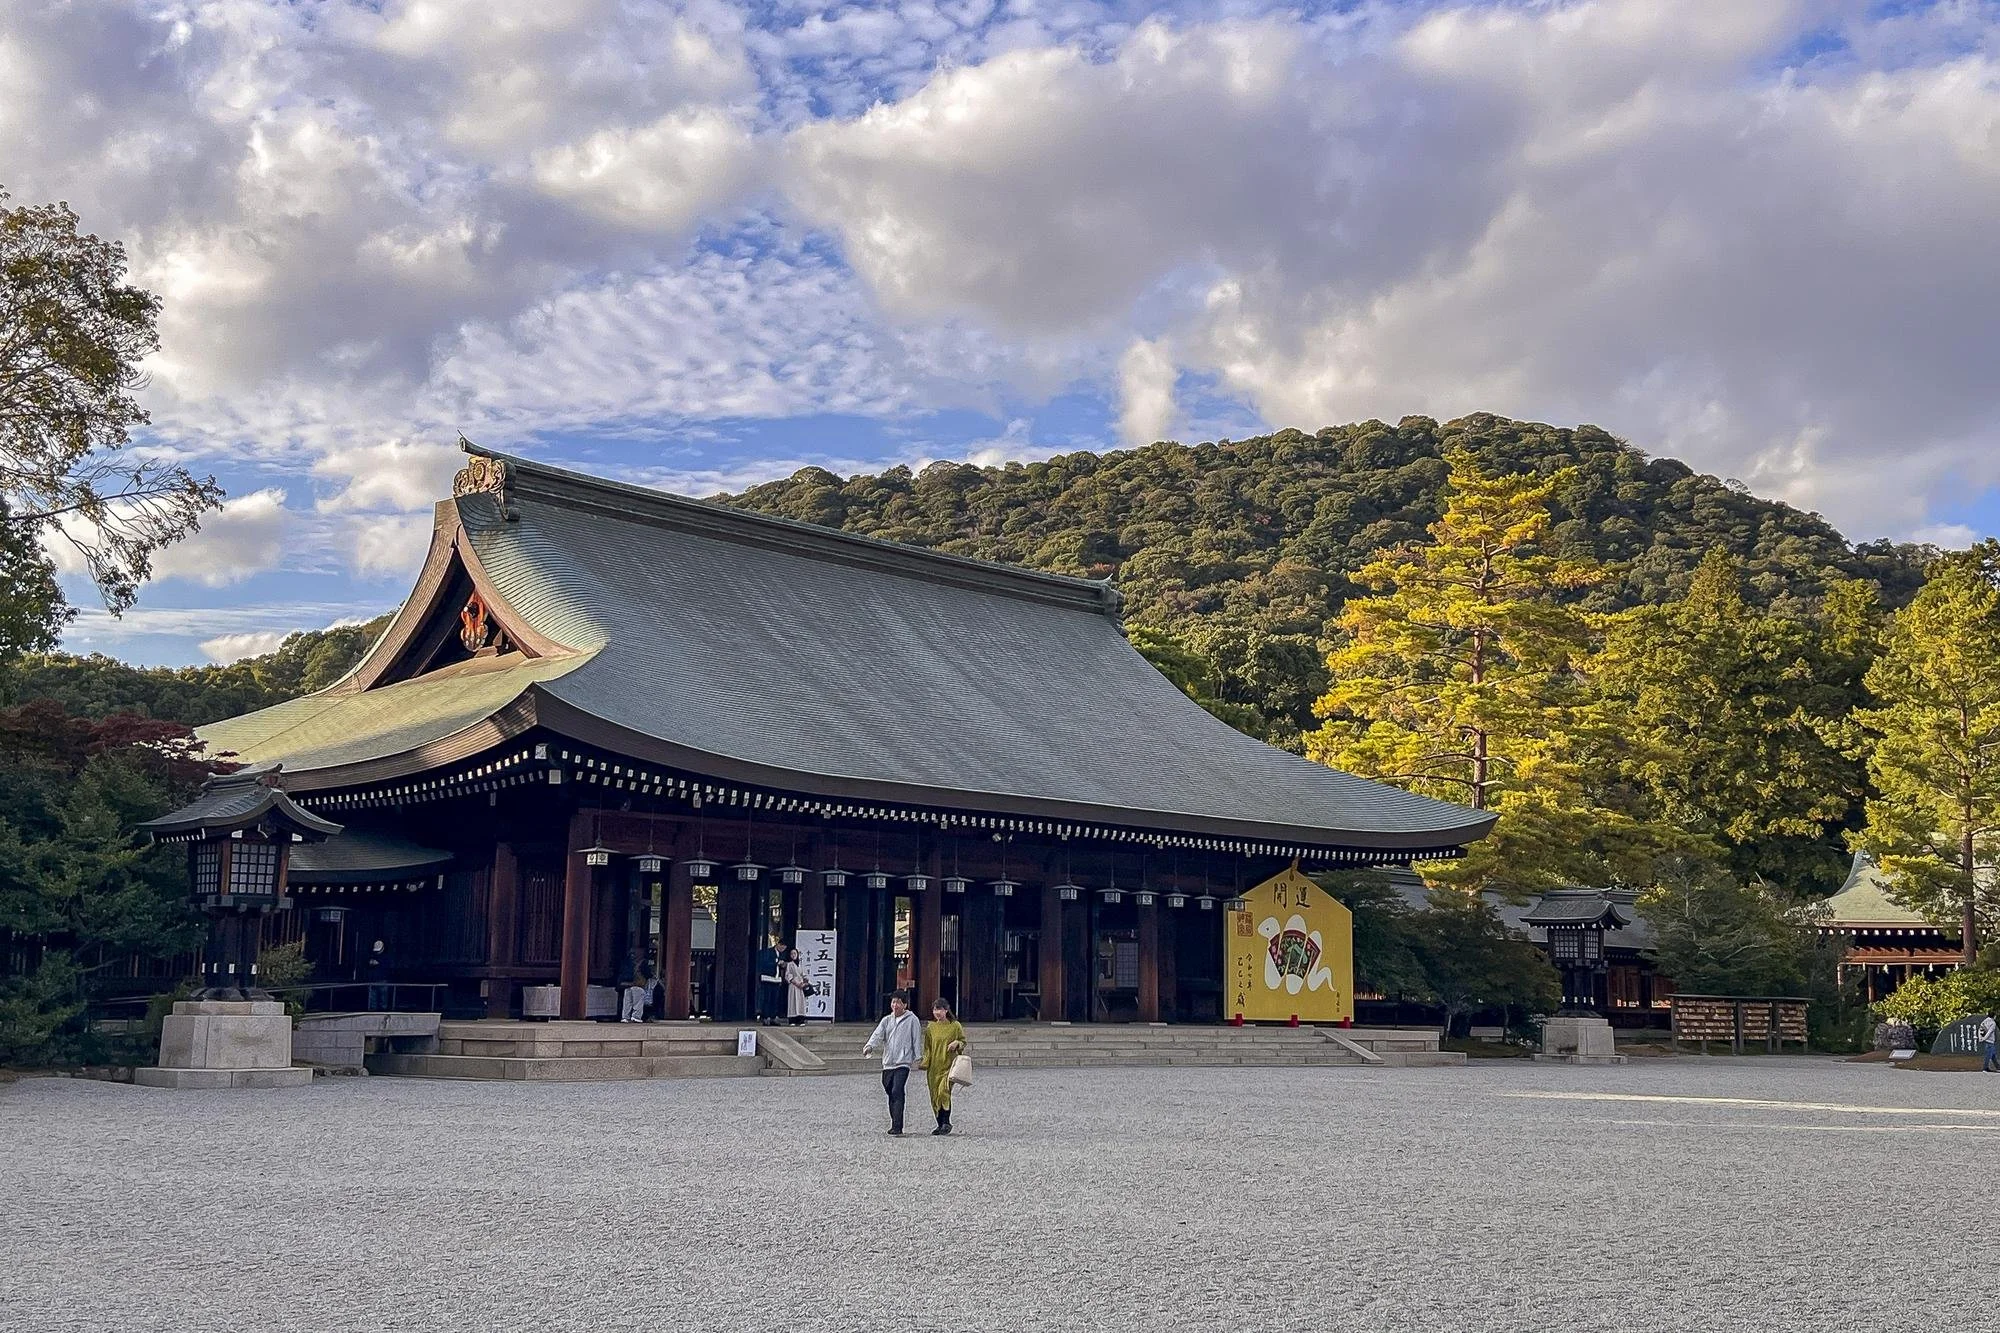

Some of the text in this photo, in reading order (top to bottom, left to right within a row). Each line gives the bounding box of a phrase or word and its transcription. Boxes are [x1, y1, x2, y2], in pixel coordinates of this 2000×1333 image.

[1273, 882, 1311, 909] 開運
[813, 933, 834, 1013] 七五三詣り
